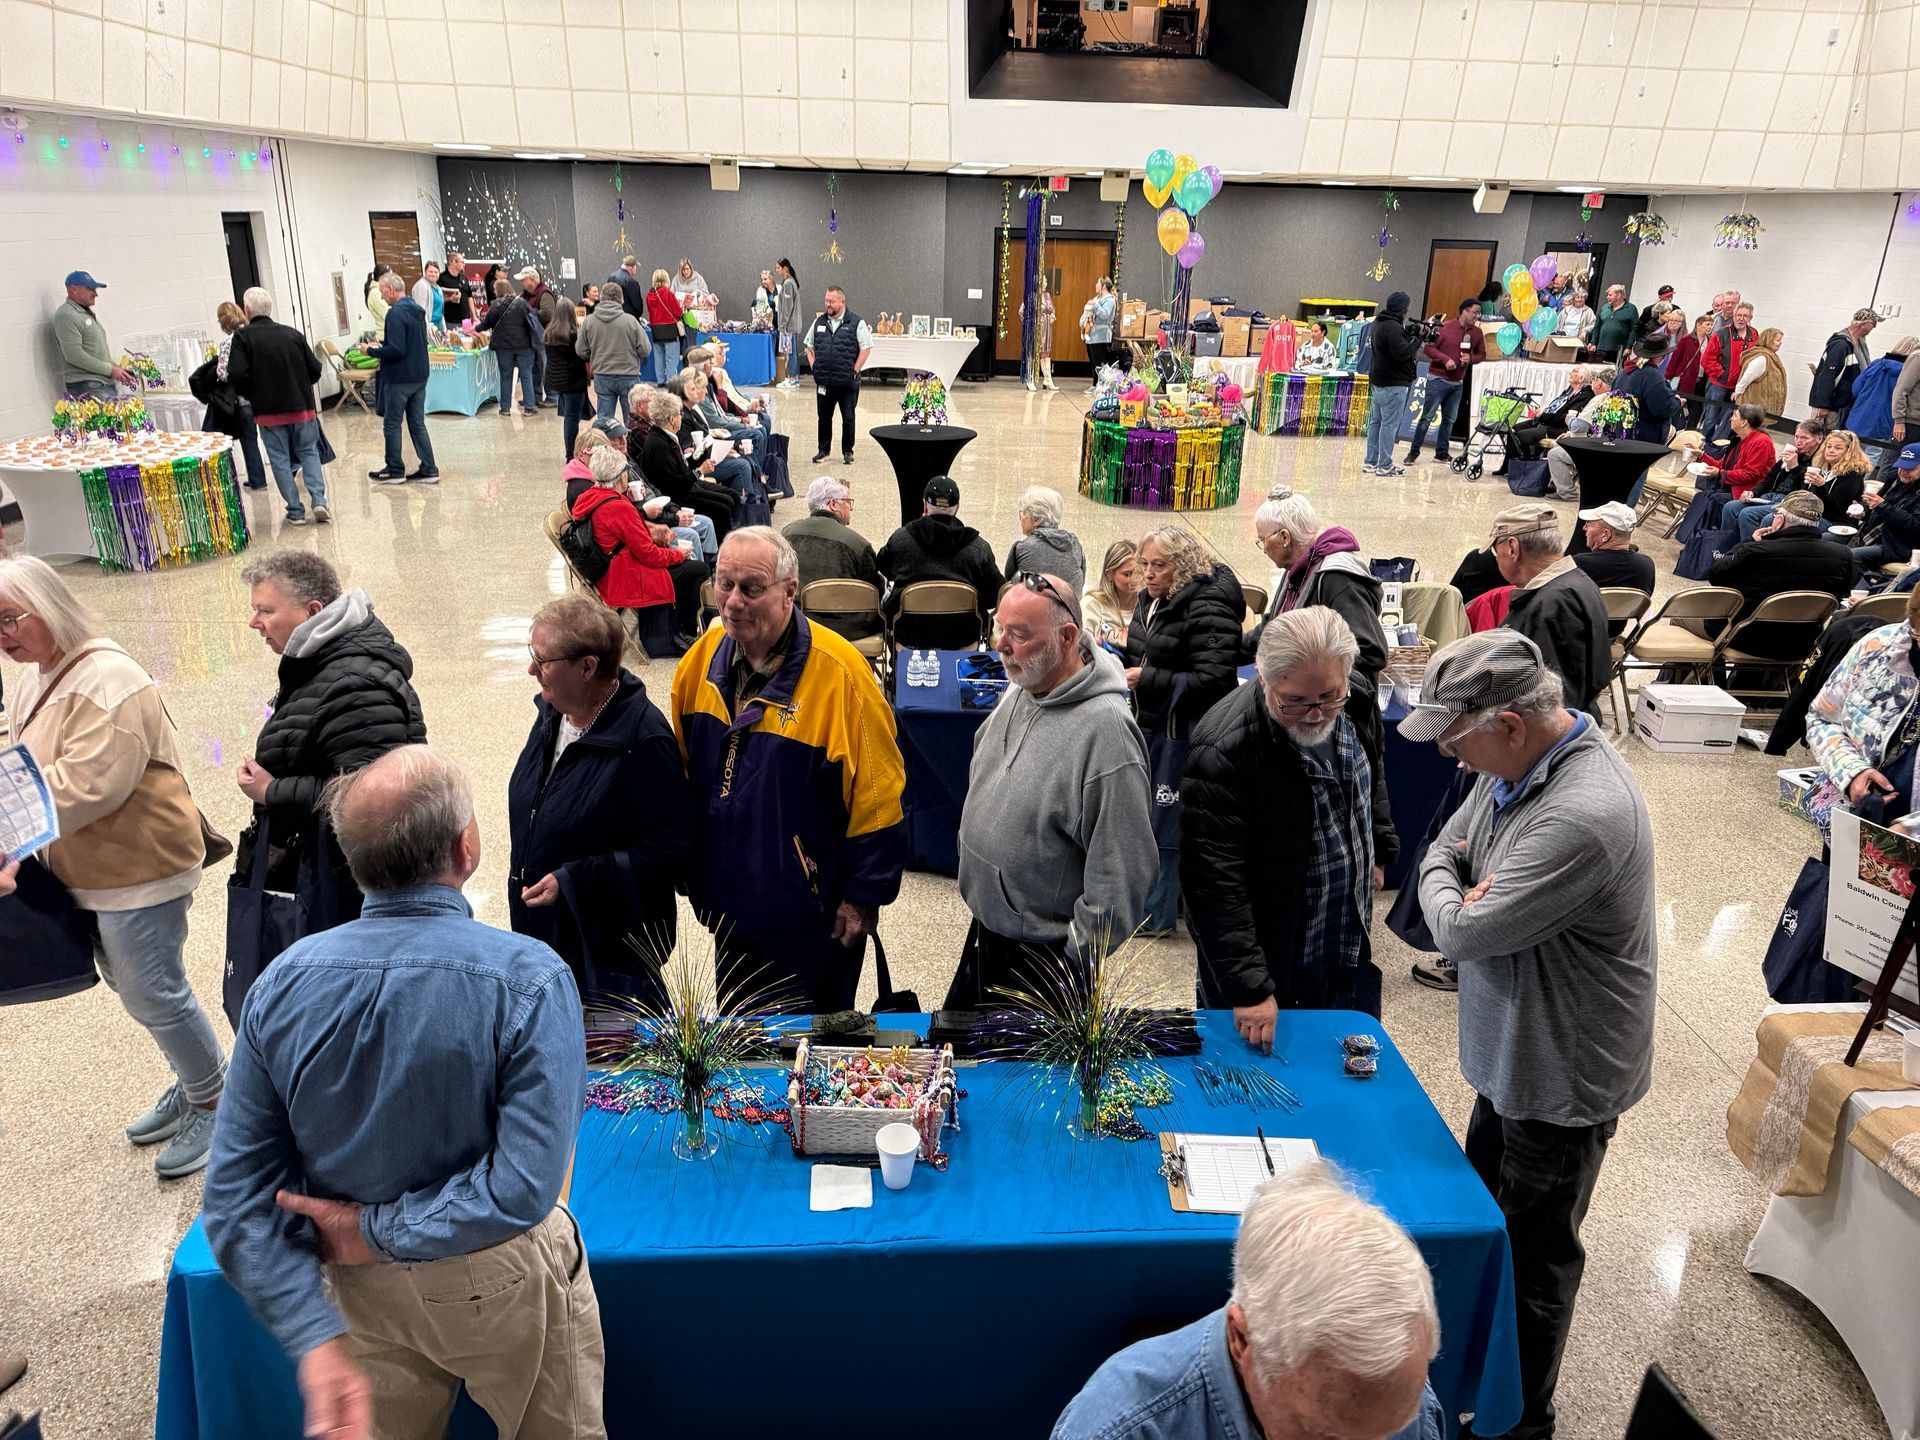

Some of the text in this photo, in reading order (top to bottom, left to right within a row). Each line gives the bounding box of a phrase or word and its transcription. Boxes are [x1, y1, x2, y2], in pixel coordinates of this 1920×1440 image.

[1097, 398, 1121, 409] FOLE
[720, 729, 741, 799] NNESOTA
[1847, 882, 1880, 902] Baldwin
[1834, 914, 1894, 944] Phone: 251-986-837
